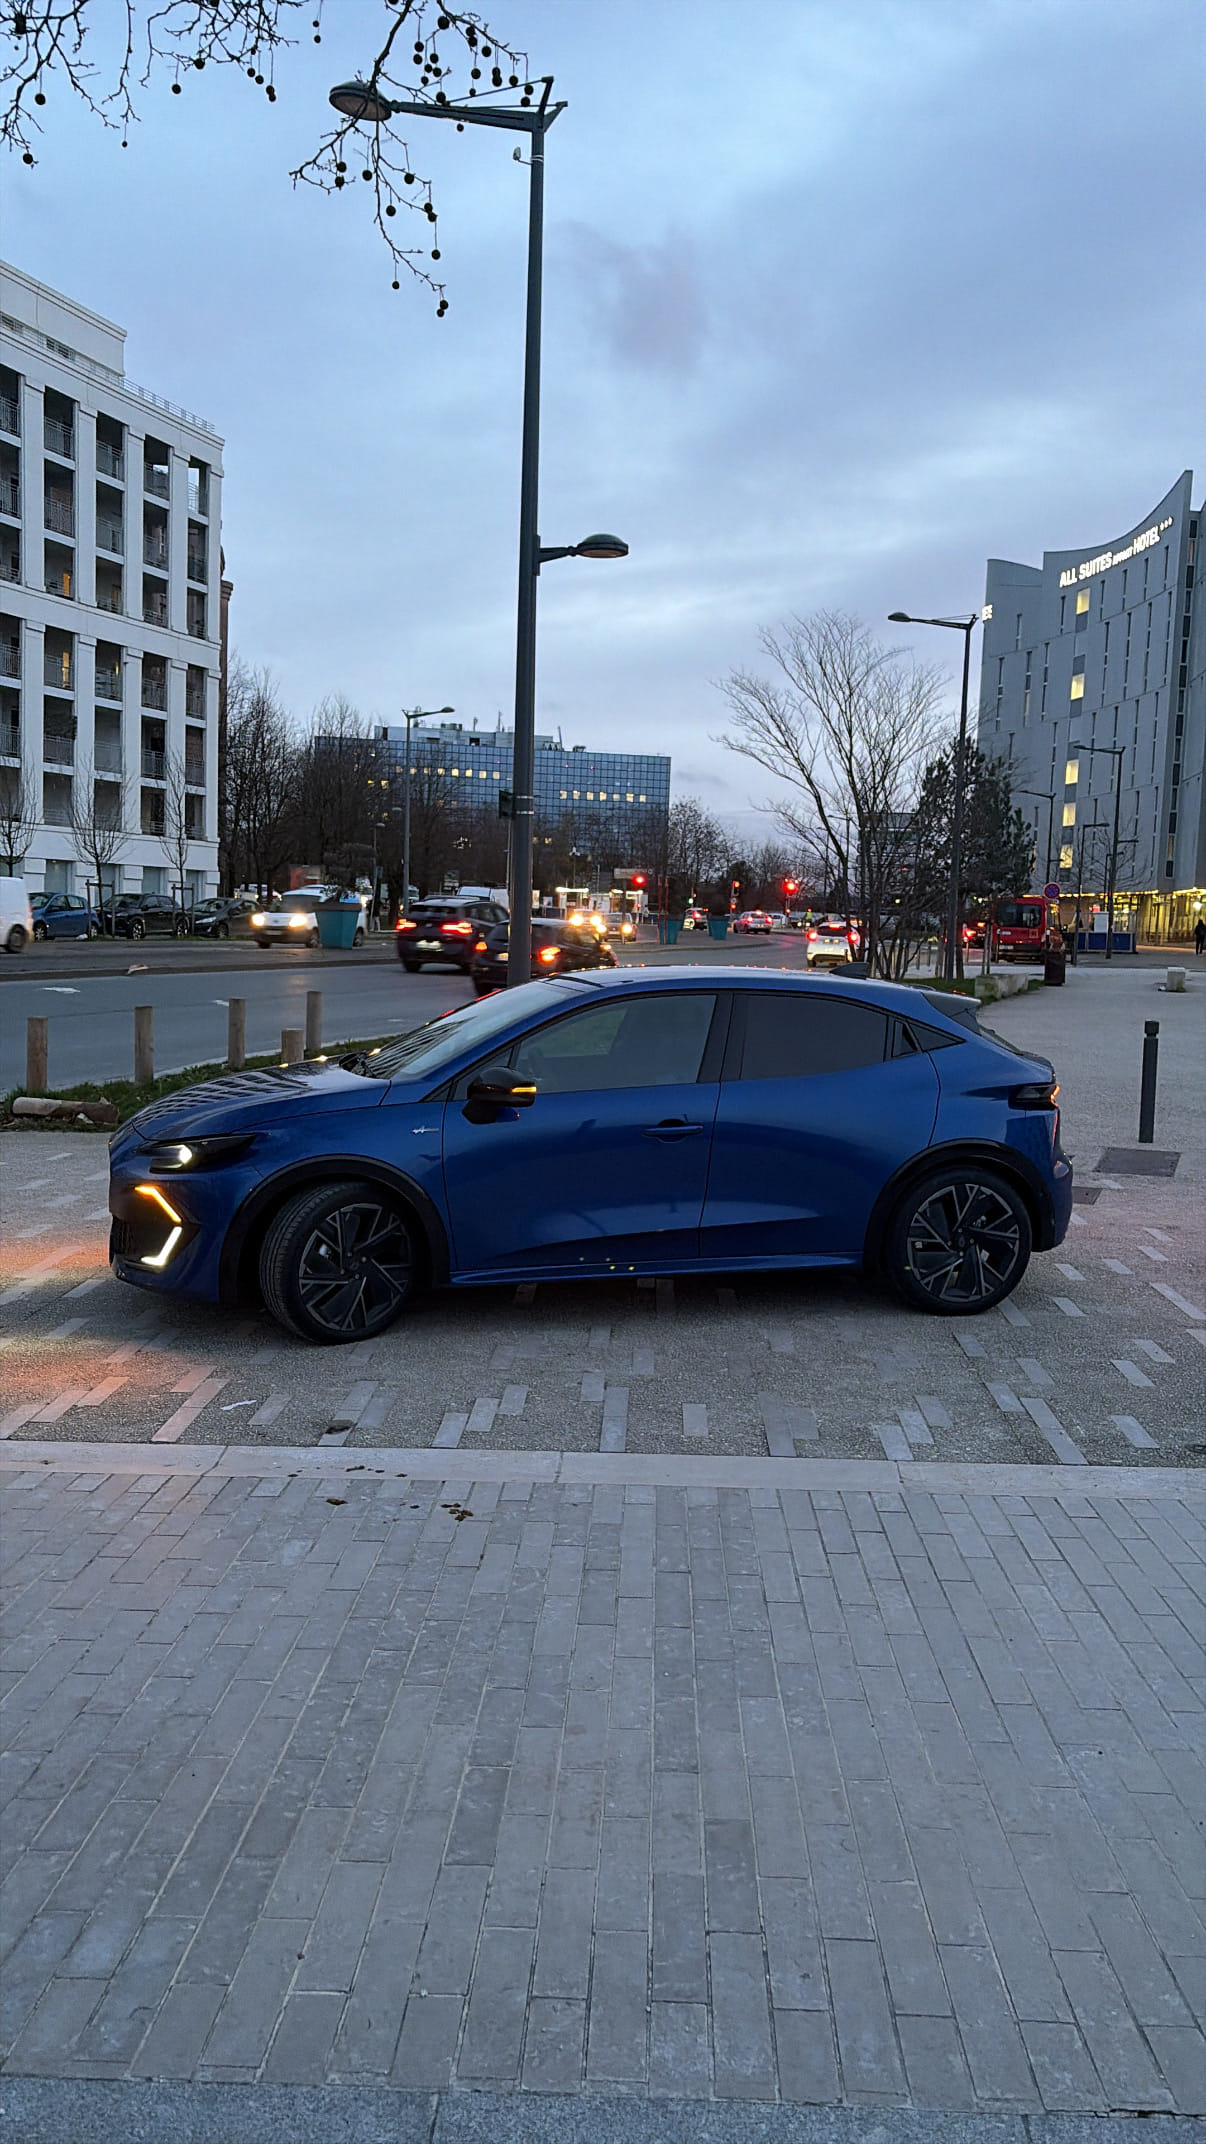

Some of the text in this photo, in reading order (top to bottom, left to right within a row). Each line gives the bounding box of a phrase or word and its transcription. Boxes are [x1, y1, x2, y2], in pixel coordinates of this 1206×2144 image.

[1059, 567, 1078, 588] ALL
[1079, 552, 1113, 580] SUITES
[1133, 525, 1161, 555] HOTEL
